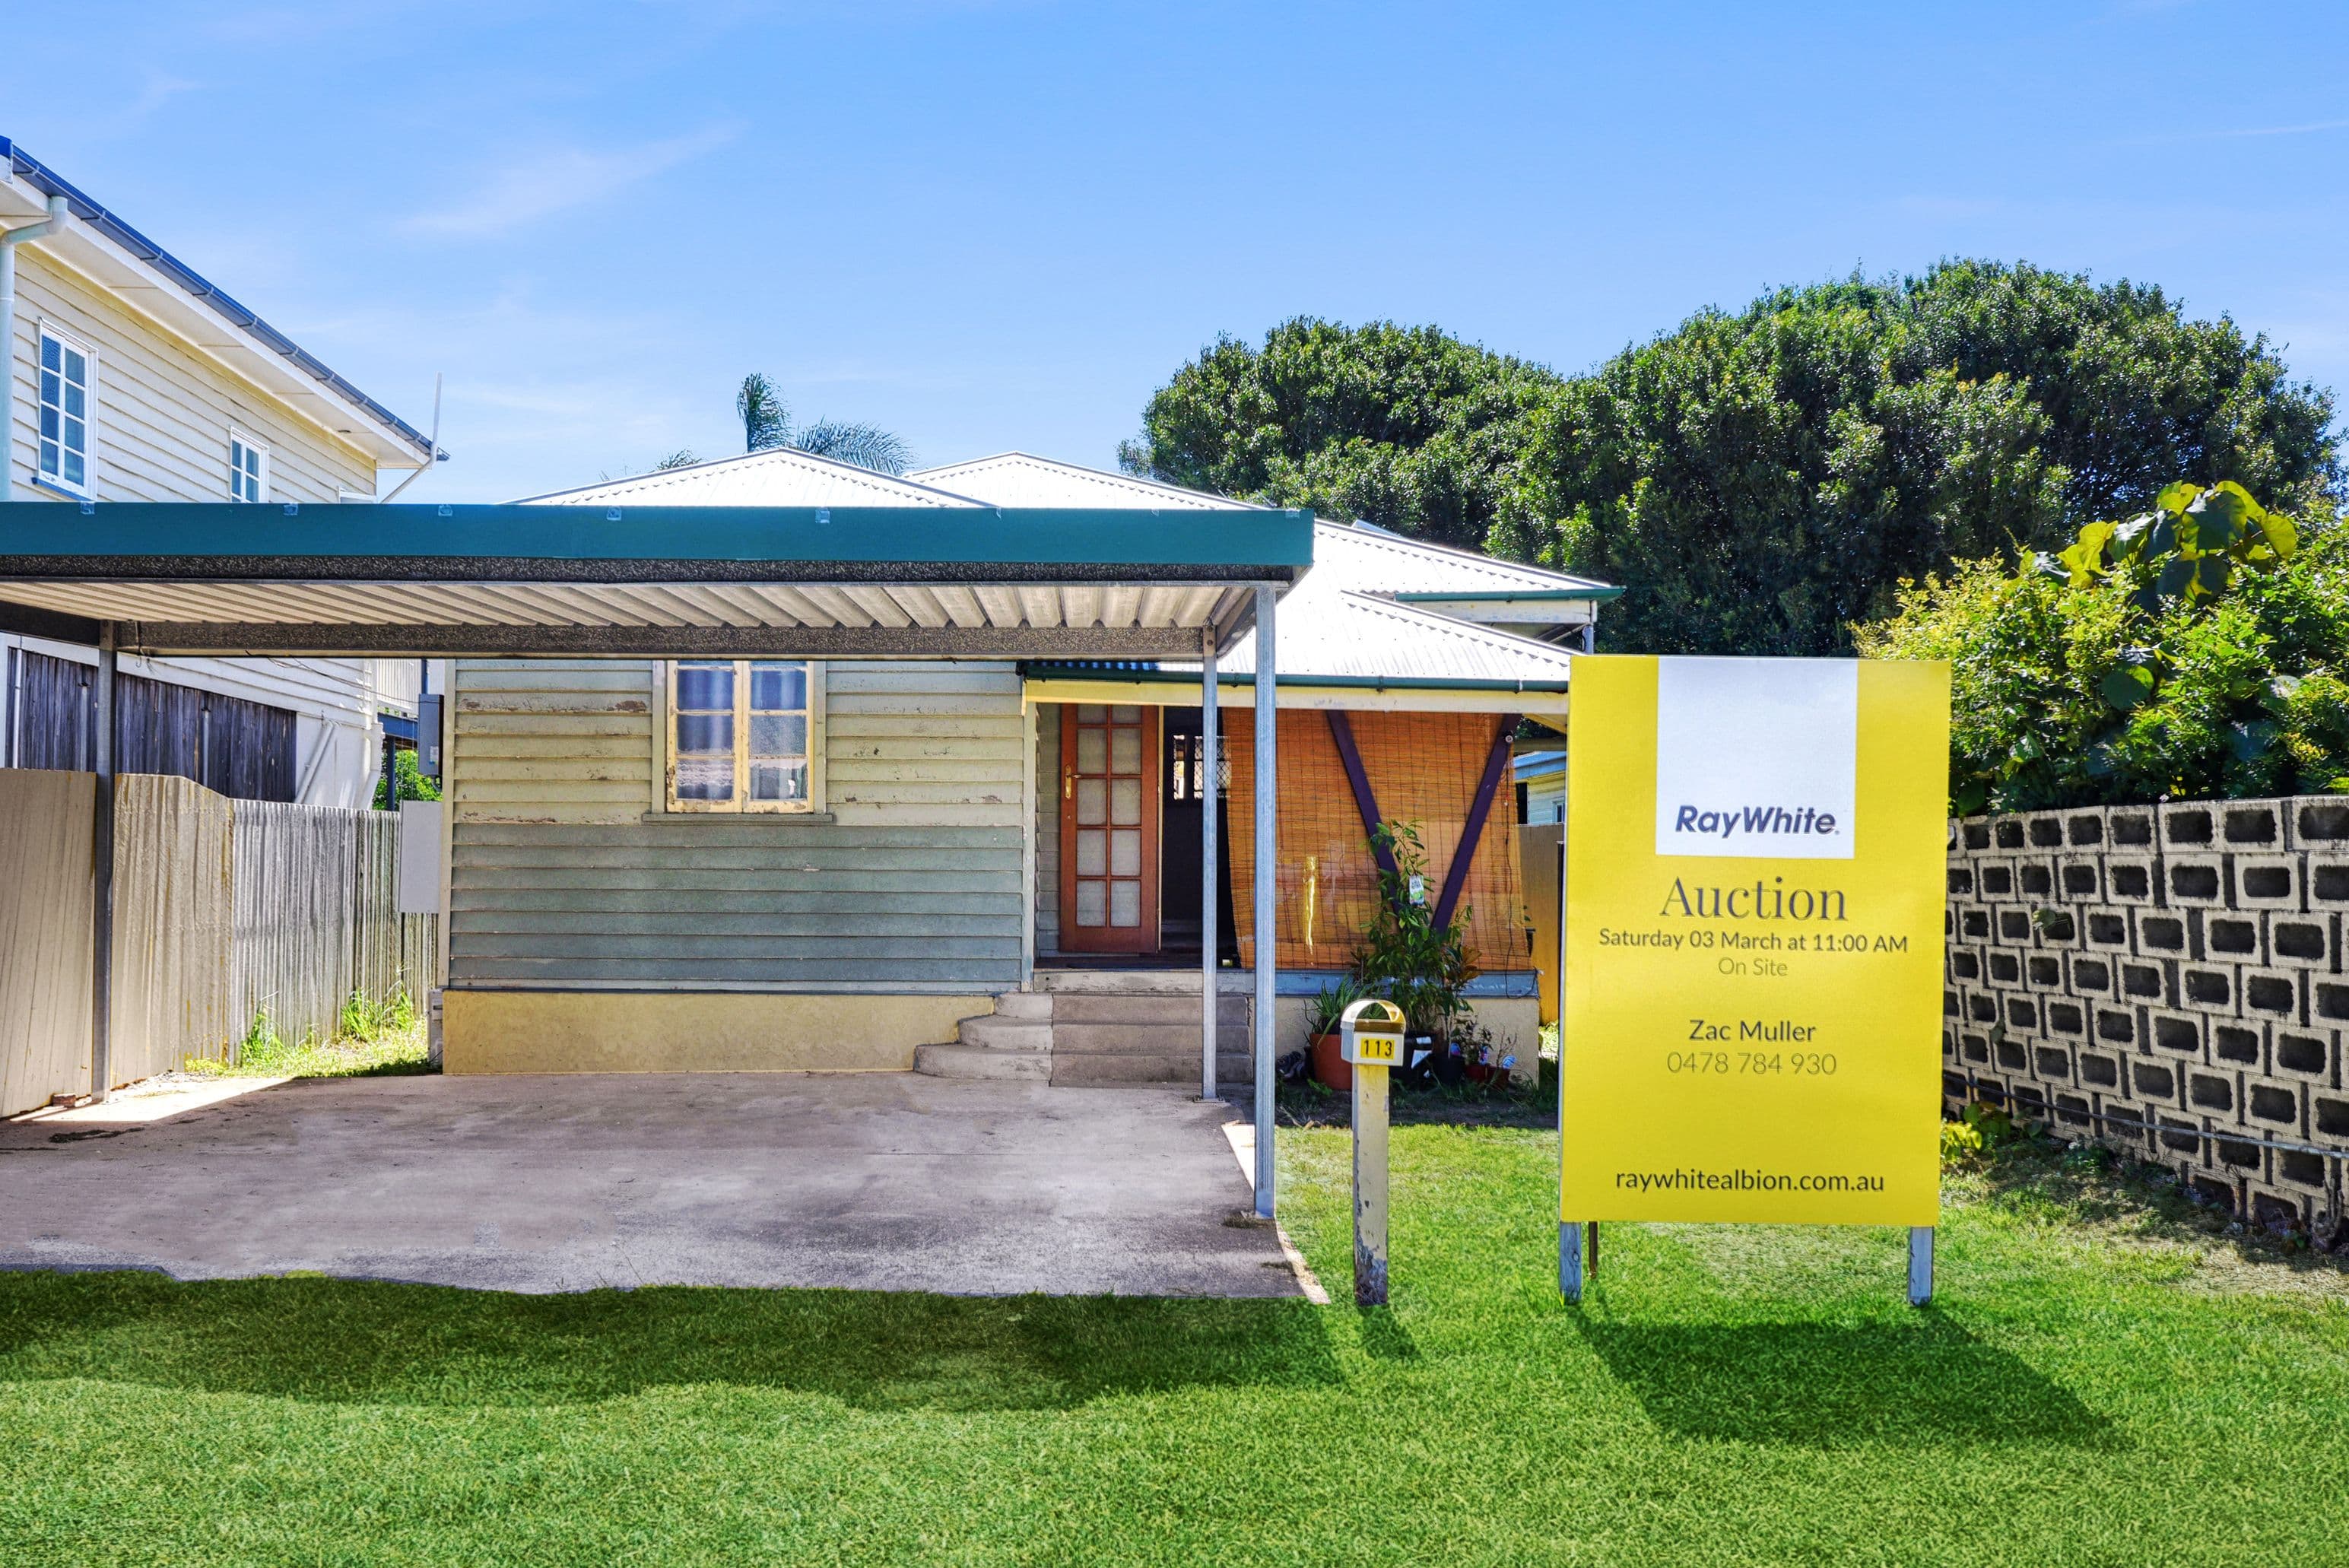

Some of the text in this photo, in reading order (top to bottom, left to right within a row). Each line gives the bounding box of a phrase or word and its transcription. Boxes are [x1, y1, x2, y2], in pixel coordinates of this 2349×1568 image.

[1659, 875, 1849, 922] Auction
[1598, 928, 1908, 954] Saturday 03 March at 11:00 AM
[1718, 956, 1789, 977] On Site
[1688, 1019, 1817, 1043] Zac Muller
[1364, 1040, 1392, 1056] 113
[1667, 1051, 1837, 1076] 0478 784 930
[1616, 1167, 1884, 1194] raywhitealbion.com.au
